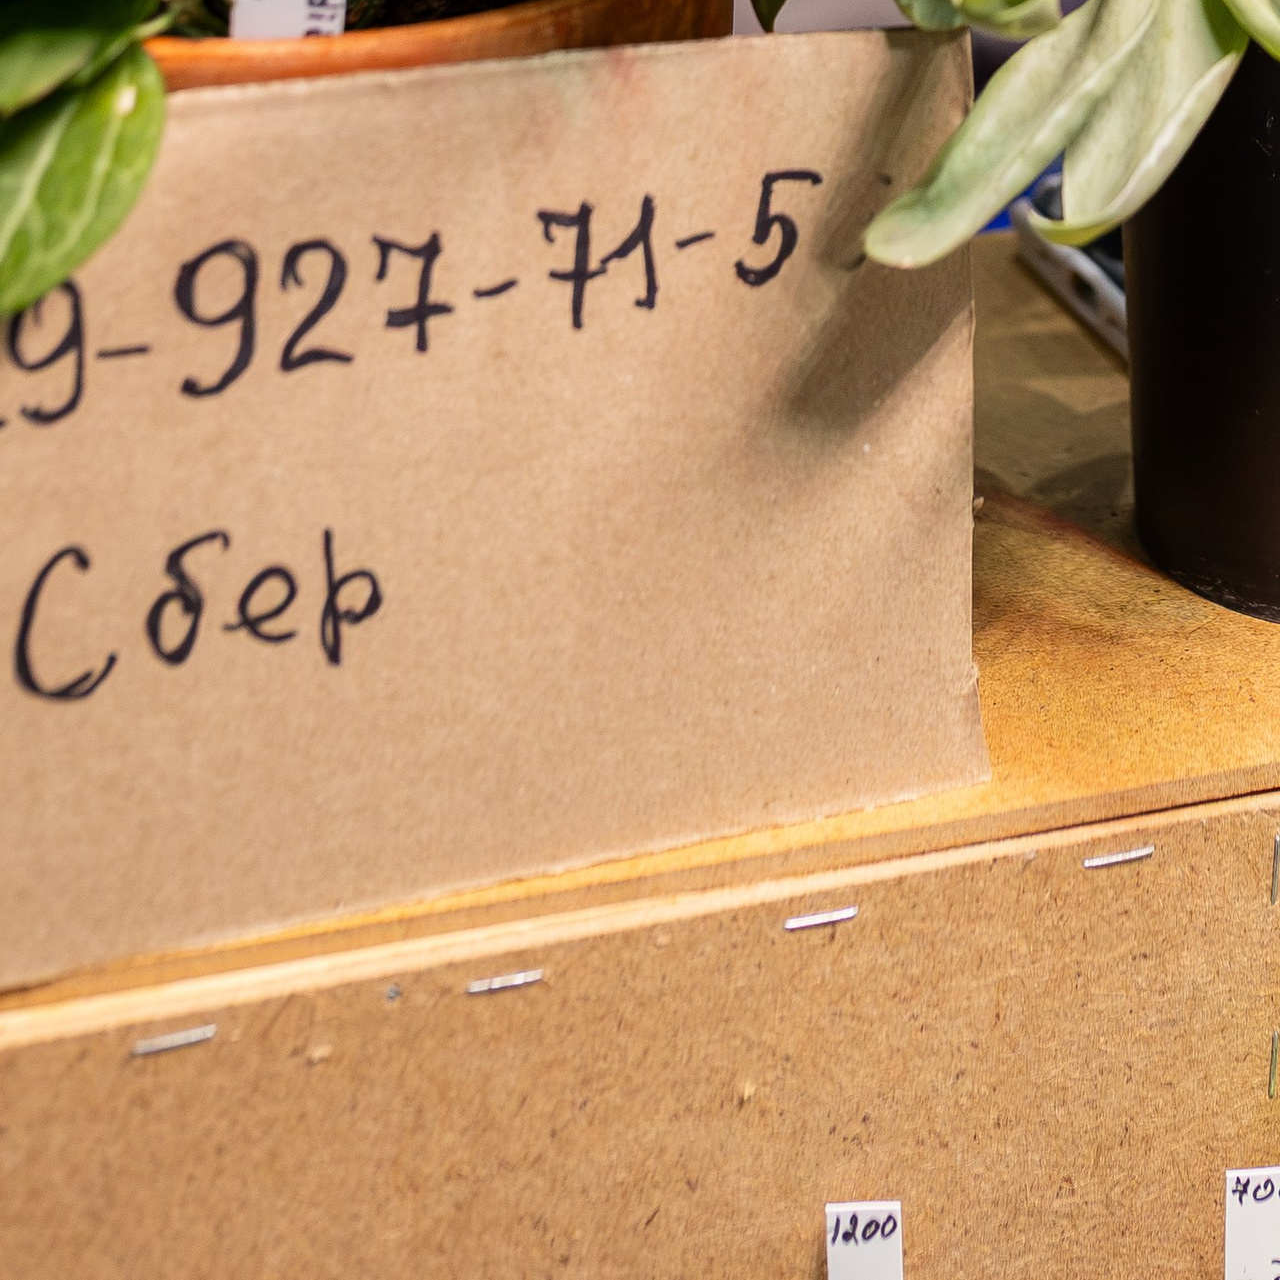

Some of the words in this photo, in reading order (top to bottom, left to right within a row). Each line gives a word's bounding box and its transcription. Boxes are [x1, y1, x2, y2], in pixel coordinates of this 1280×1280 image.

[0, 170, 892, 427] 9-927-71-5
[14, 527, 383, 701] Сбер
[831, 1213, 898, 1247] 1200
